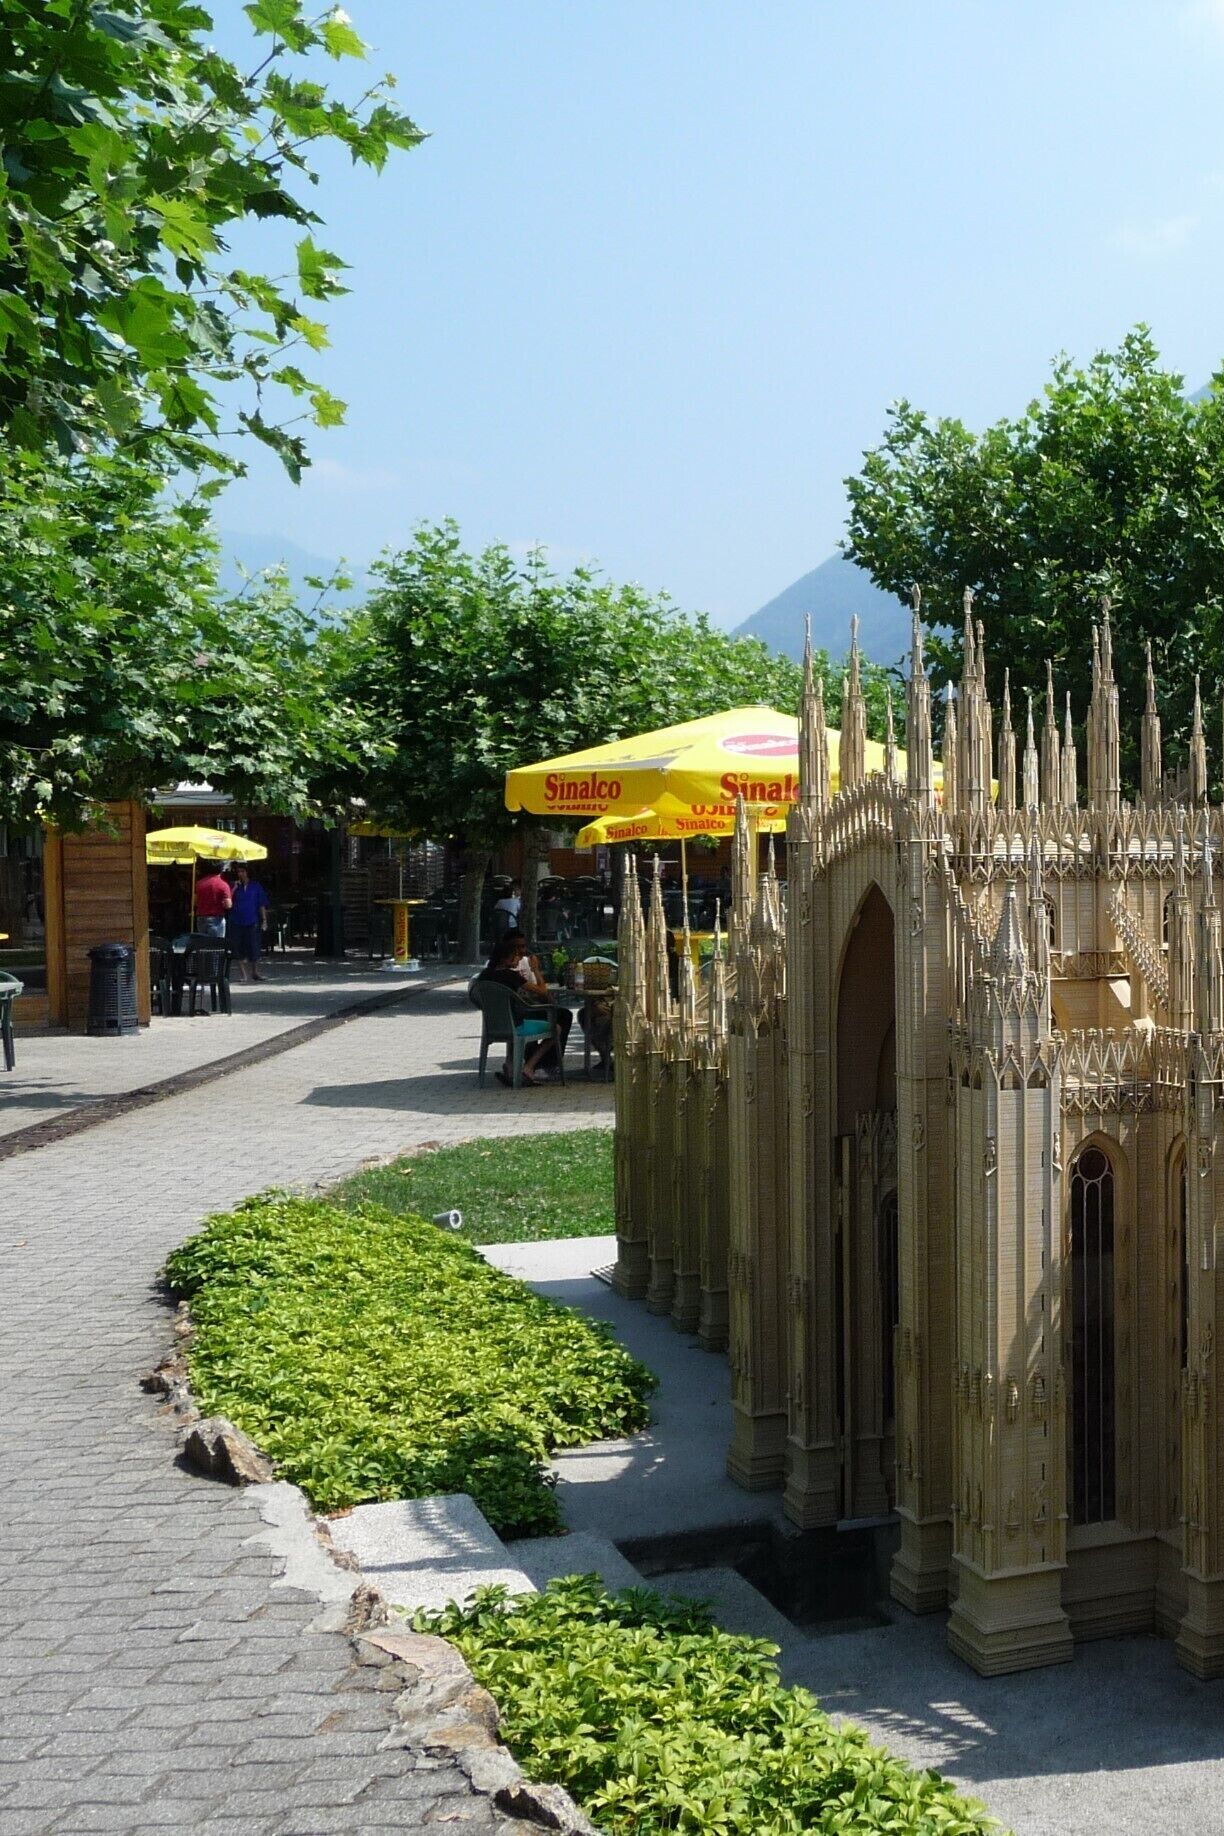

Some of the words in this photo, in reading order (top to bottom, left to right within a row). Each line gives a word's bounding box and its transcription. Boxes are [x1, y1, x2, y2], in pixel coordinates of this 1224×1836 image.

[544, 771, 622, 802] Sinalco
[605, 823, 648, 840] Sinalco
[675, 817, 726, 831] Sinalco
